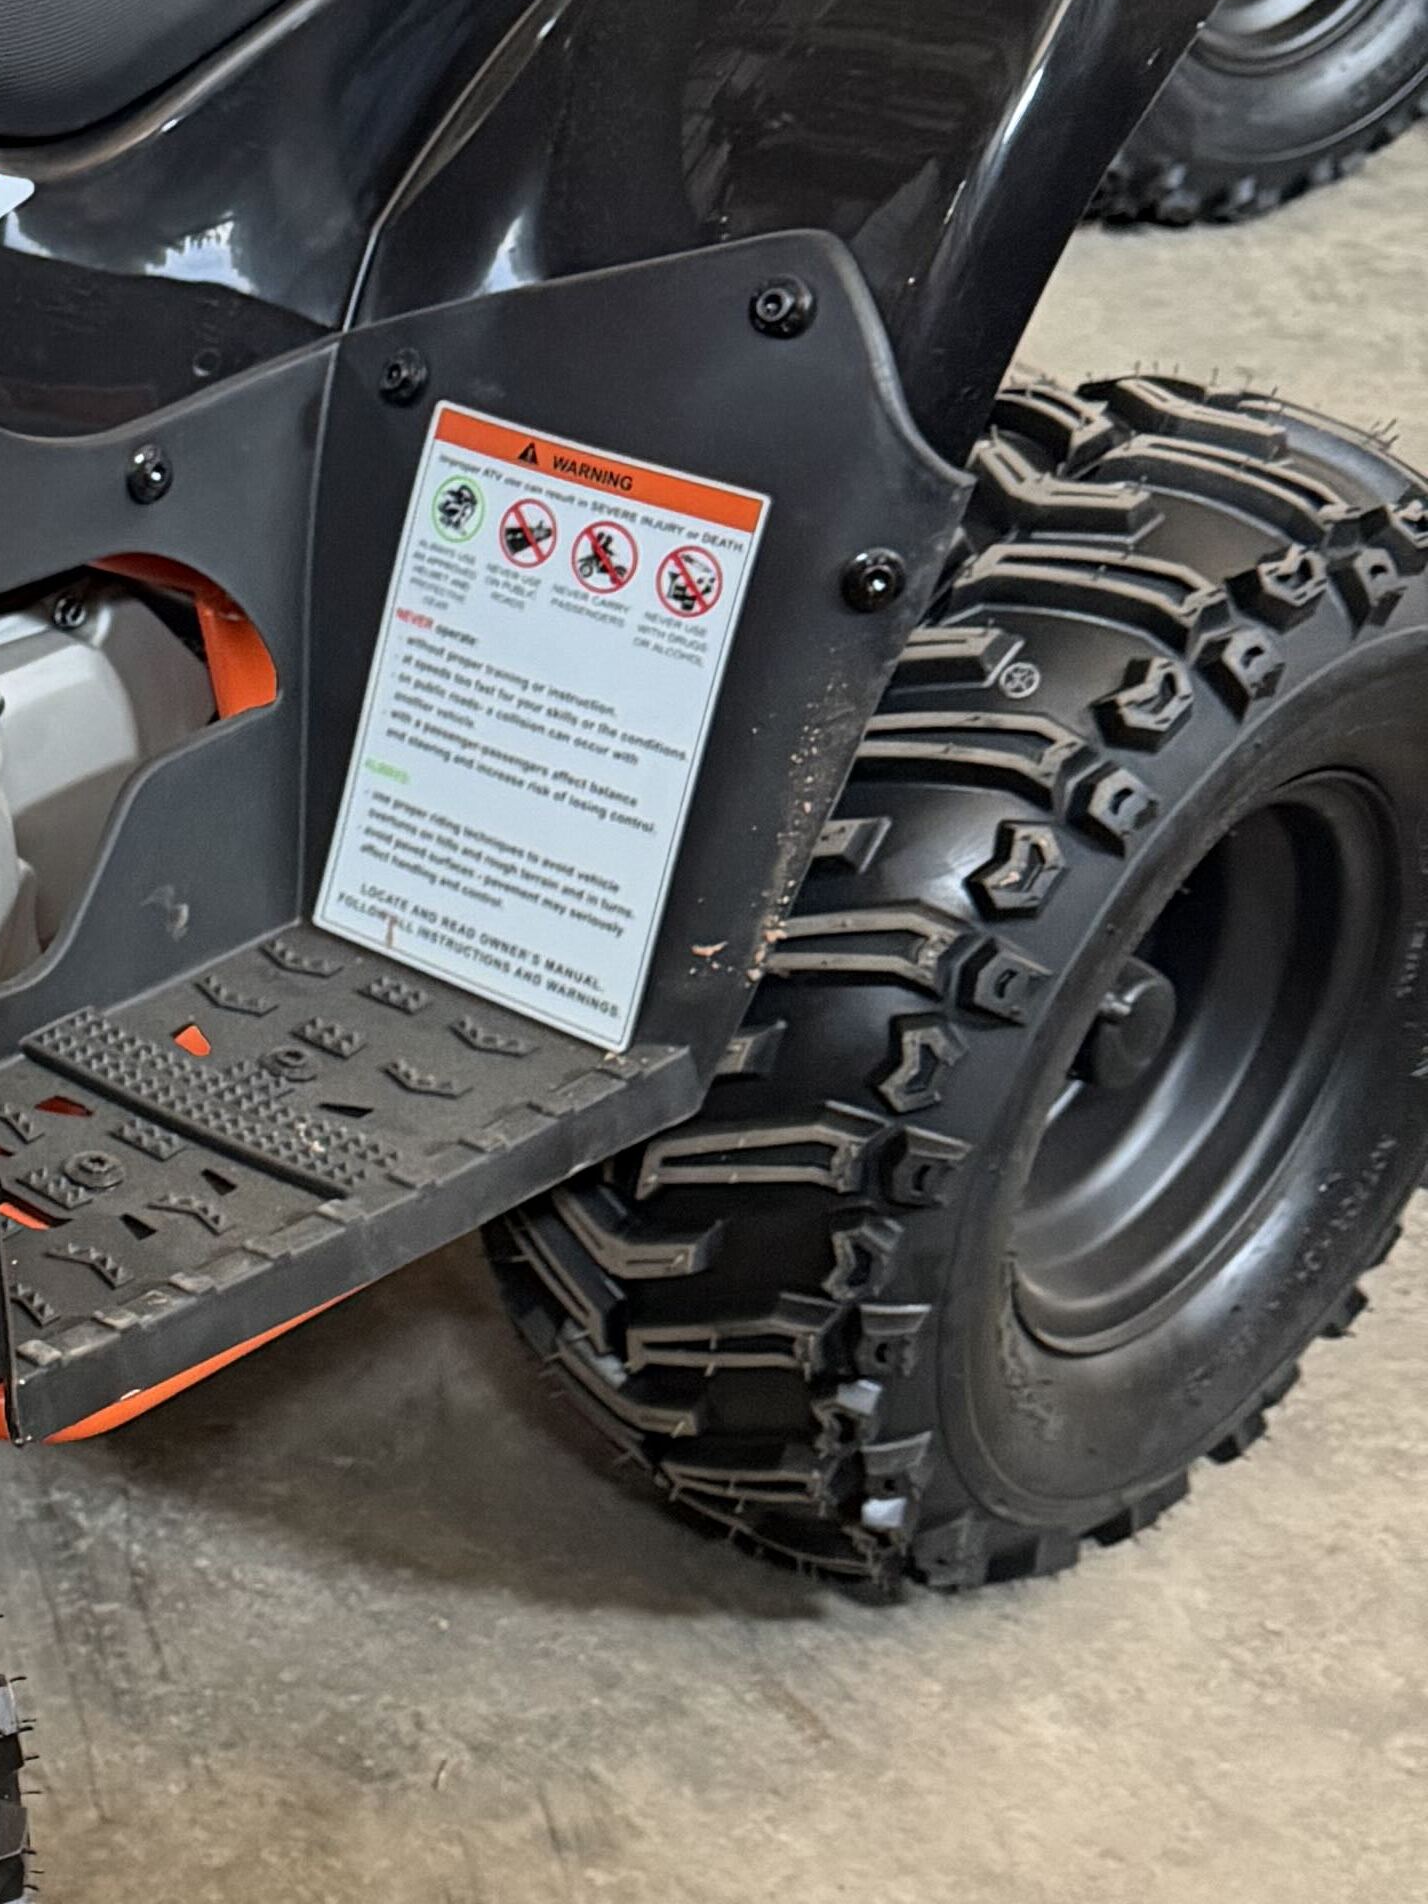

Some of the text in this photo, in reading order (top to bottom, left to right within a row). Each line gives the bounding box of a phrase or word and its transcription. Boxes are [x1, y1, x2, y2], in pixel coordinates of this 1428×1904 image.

[552, 454, 634, 493] WARNING
[590, 501, 637, 522] SEVERE
[640, 516, 684, 534] INJURY
[702, 532, 742, 552] DEATH
[396, 608, 433, 628] NEVER
[360, 883, 408, 910] LOCATE
[411, 905, 437, 922] AND
[441, 916, 475, 938] READ
[417, 927, 509, 973] INSTRUCTIONS
[513, 967, 541, 986] AND
